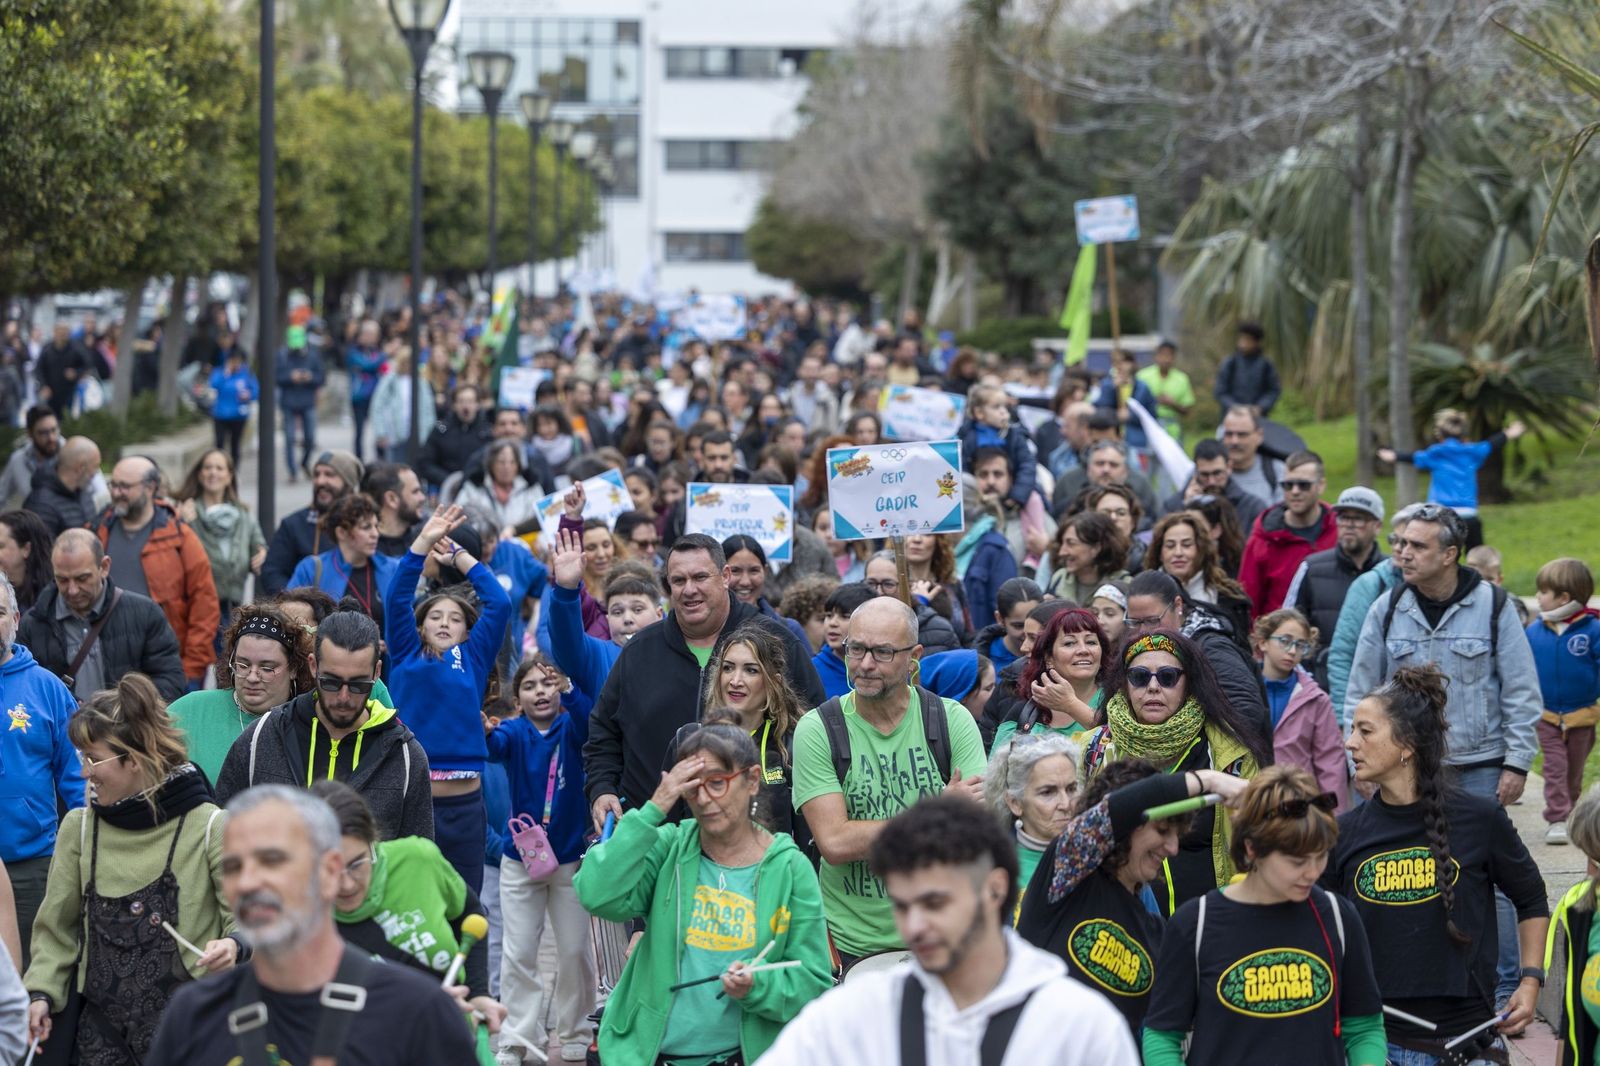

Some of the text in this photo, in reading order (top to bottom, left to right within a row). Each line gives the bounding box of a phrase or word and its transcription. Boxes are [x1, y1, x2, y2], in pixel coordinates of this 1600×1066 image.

[881, 471, 906, 484] CEIP
[875, 494, 918, 512] GADIR
[1375, 857, 1436, 876] SAMBA
[1374, 872, 1435, 893] WAMBA
[692, 899, 746, 923] AMBA
[1098, 930, 1140, 972] SAMBA
[1089, 940, 1138, 986] WAMBA
[1244, 962, 1312, 985] SAMBA
[1245, 980, 1313, 1003] WAMBA
